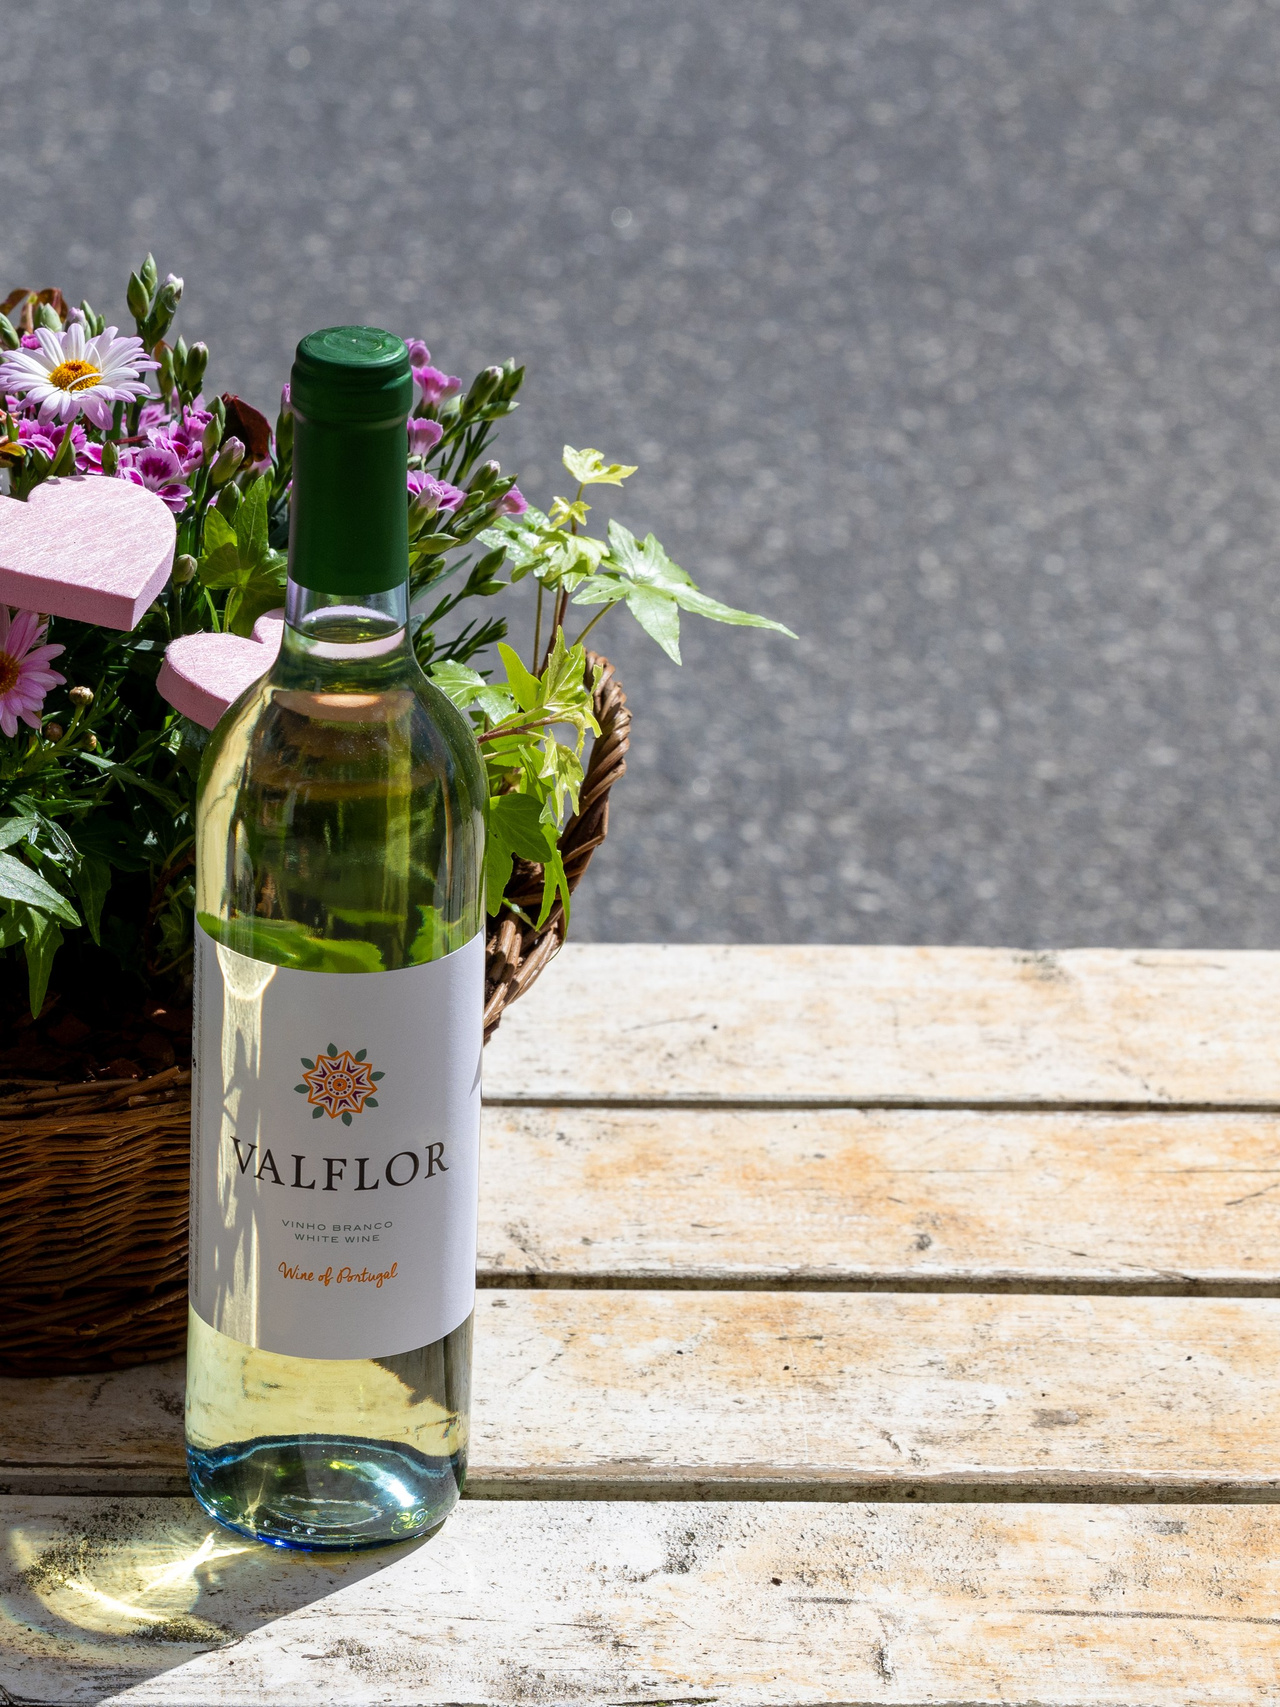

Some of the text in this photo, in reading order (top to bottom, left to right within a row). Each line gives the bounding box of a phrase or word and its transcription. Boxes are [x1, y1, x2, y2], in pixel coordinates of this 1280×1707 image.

[230, 1135, 449, 1192] VALFLOR
[281, 1219, 393, 1232] VINHO BRANCO
[294, 1233, 380, 1243] WHITE WINE
[278, 1261, 399, 1288] Wine of Portugal
